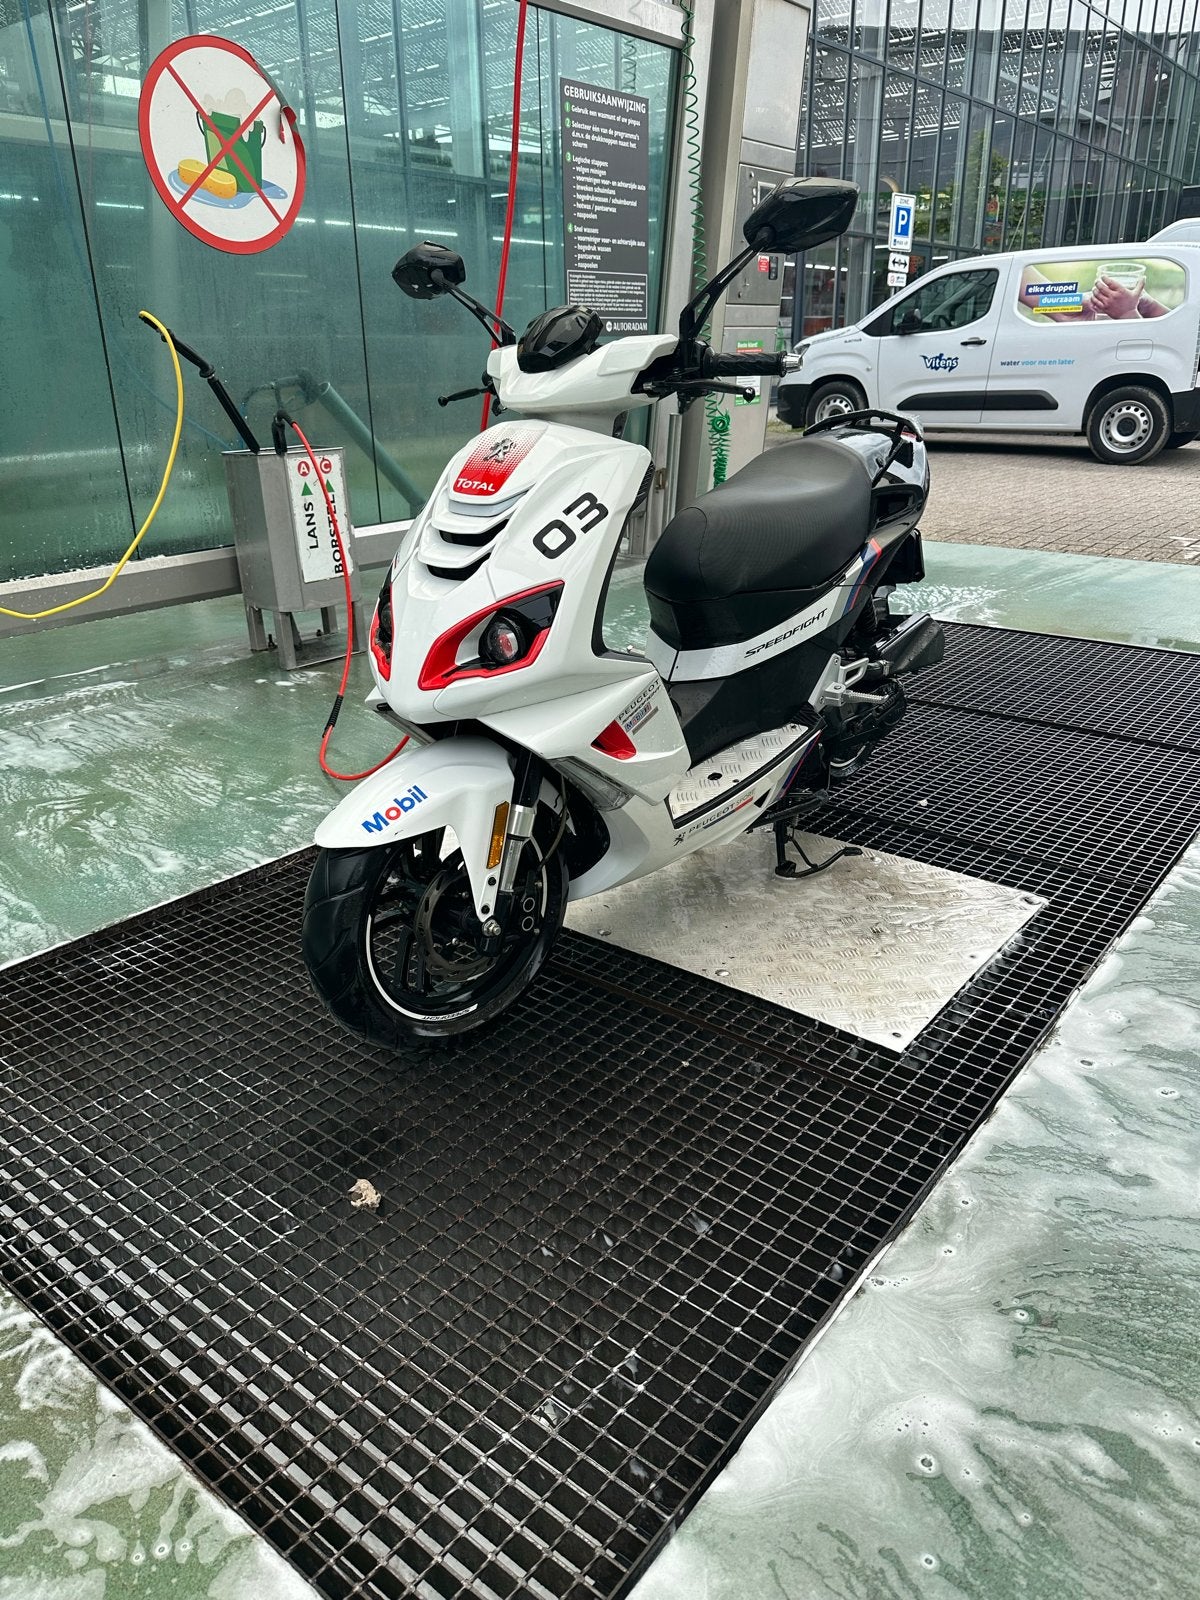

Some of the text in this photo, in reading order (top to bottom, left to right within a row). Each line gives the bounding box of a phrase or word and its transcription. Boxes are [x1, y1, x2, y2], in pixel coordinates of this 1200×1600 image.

[564, 85, 646, 113] GEBRUIKSAANWIJZING
[571, 103, 589, 115] Gebruik
[571, 120, 591, 131] Selecteer
[572, 140, 588, 149] scherm
[572, 155, 590, 165] Logische
[897, 209, 908, 234] P
[1028, 283, 1076, 293] elke druppel
[1041, 295, 1081, 304] duurzaam
[612, 321, 648, 332] AUTORADAM
[923, 354, 959, 371] Vitens
[1057, 358, 1075, 366] later
[320, 460, 332, 473] C
[303, 501, 319, 549] LANS
[532, 492, 609, 560] 03
[743, 607, 828, 659] SPEEDFIGHT
[618, 678, 660, 721] PEUGEOT
[361, 784, 428, 834] Mobil
[688, 803, 736, 834] PEUGEOT
